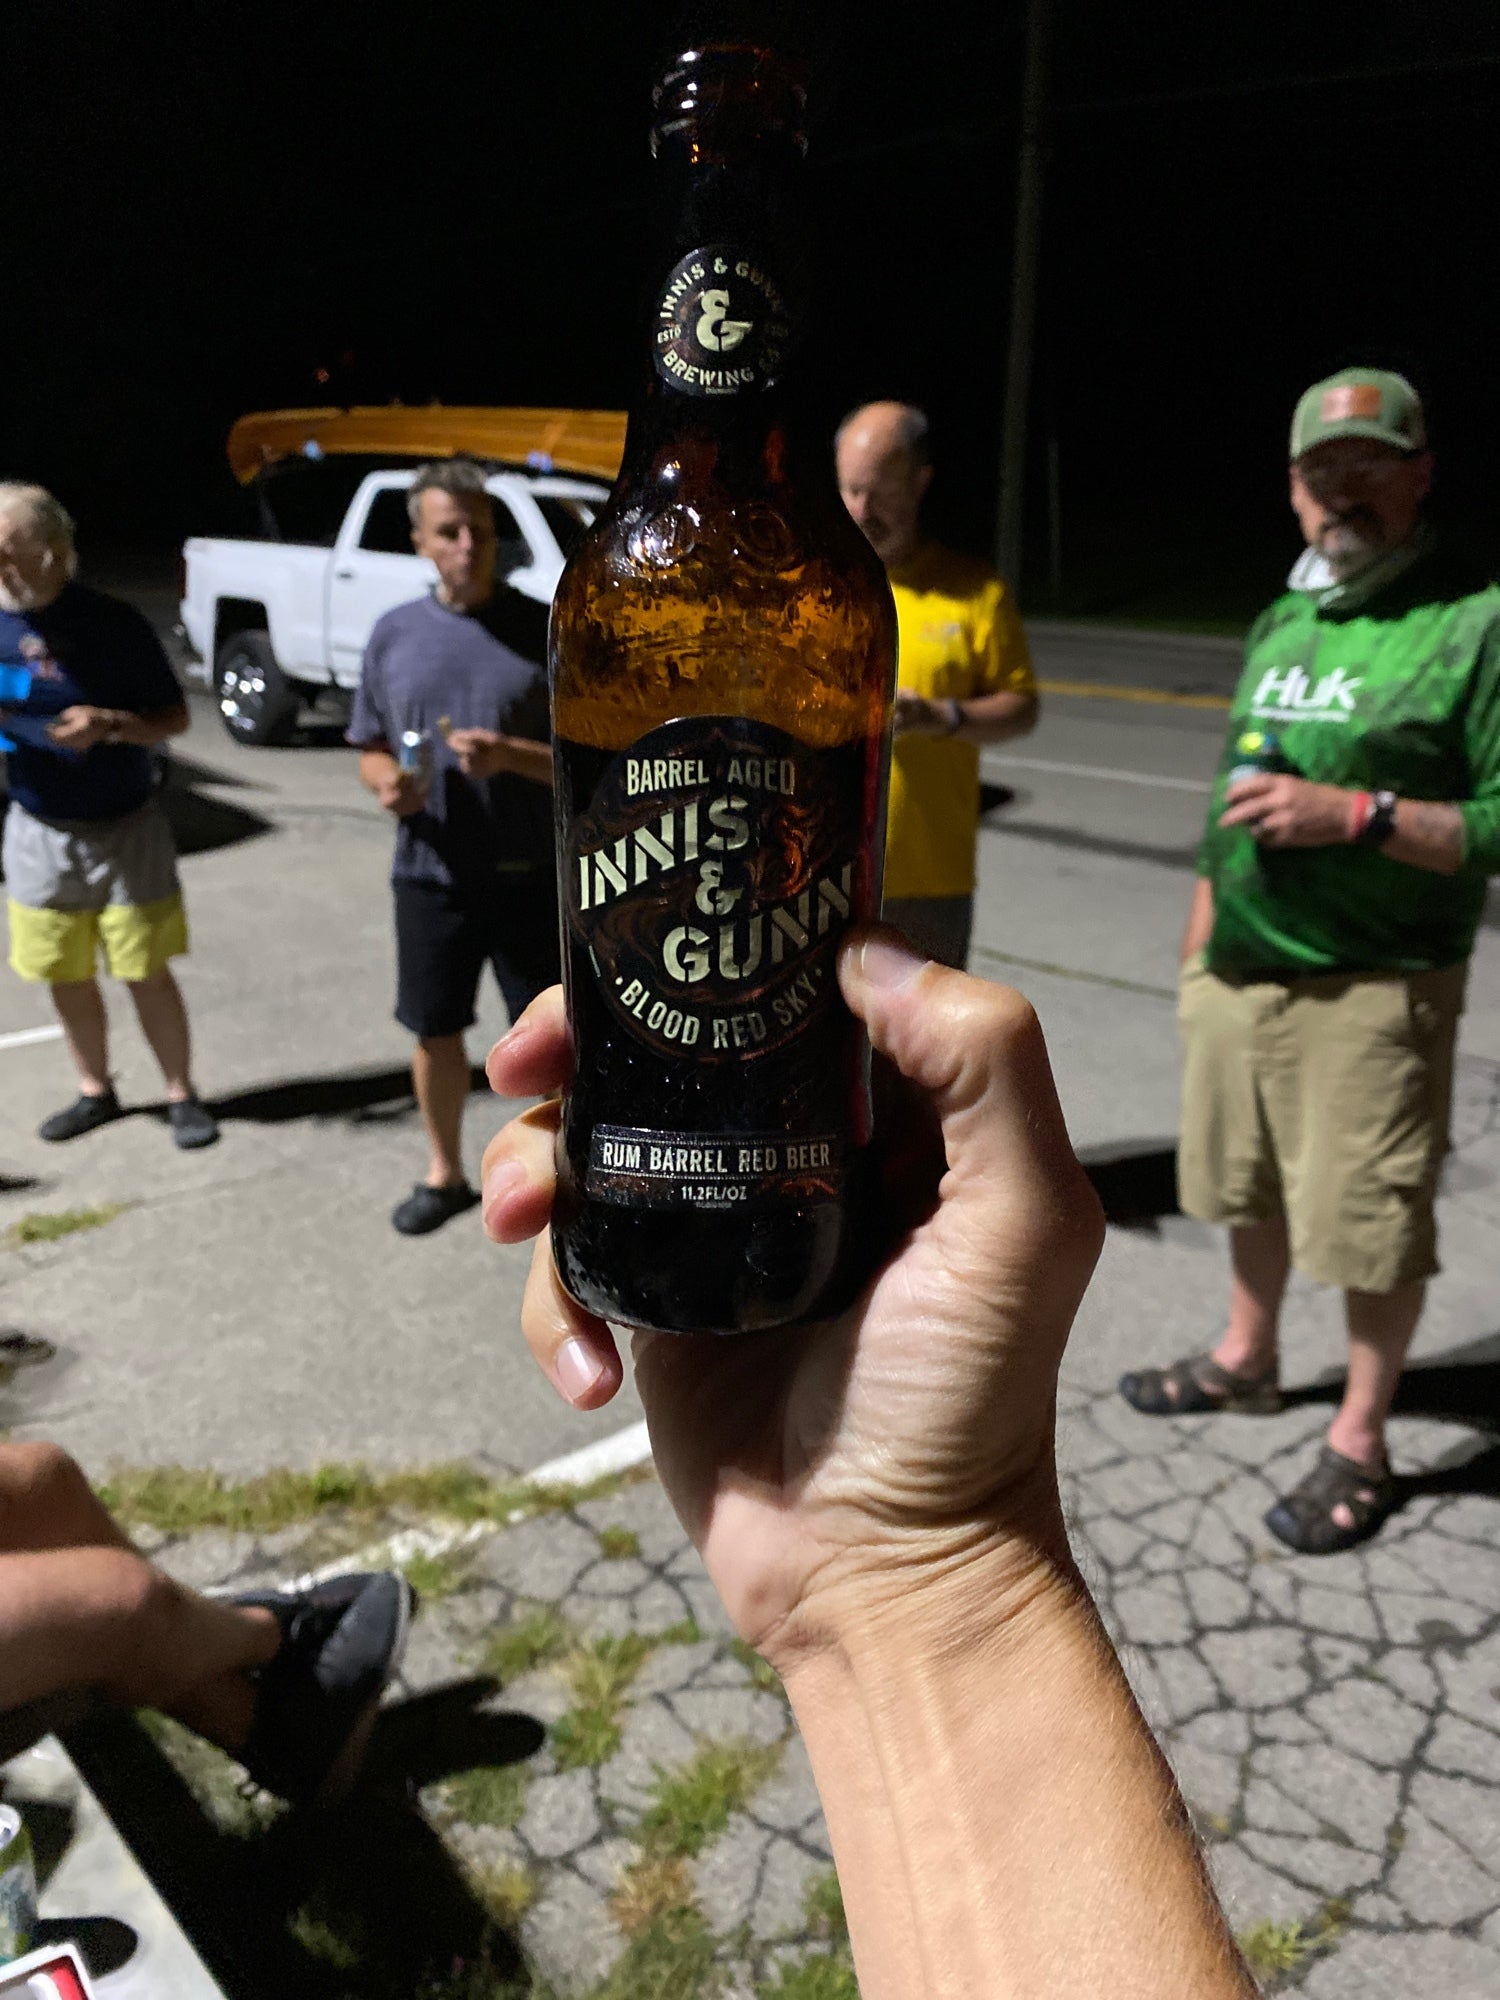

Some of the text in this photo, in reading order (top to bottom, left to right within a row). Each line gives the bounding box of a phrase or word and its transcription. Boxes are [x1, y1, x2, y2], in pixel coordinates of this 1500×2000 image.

[660, 263, 705, 318] INNIS
[713, 257, 728, 275] &
[696, 288, 754, 352] &
[662, 349, 755, 387] BREWING
[626, 758, 796, 796] BARREL AGED
[579, 795, 750, 911] INNIS
[695, 858, 744, 916] &
[662, 861, 852, 983] GUNN
[619, 972, 818, 1049] BLOOD RED SKY
[602, 1141, 831, 1174] RUM BARREL RED BEER
[681, 1185, 747, 1201] 11.2FL/OZ
